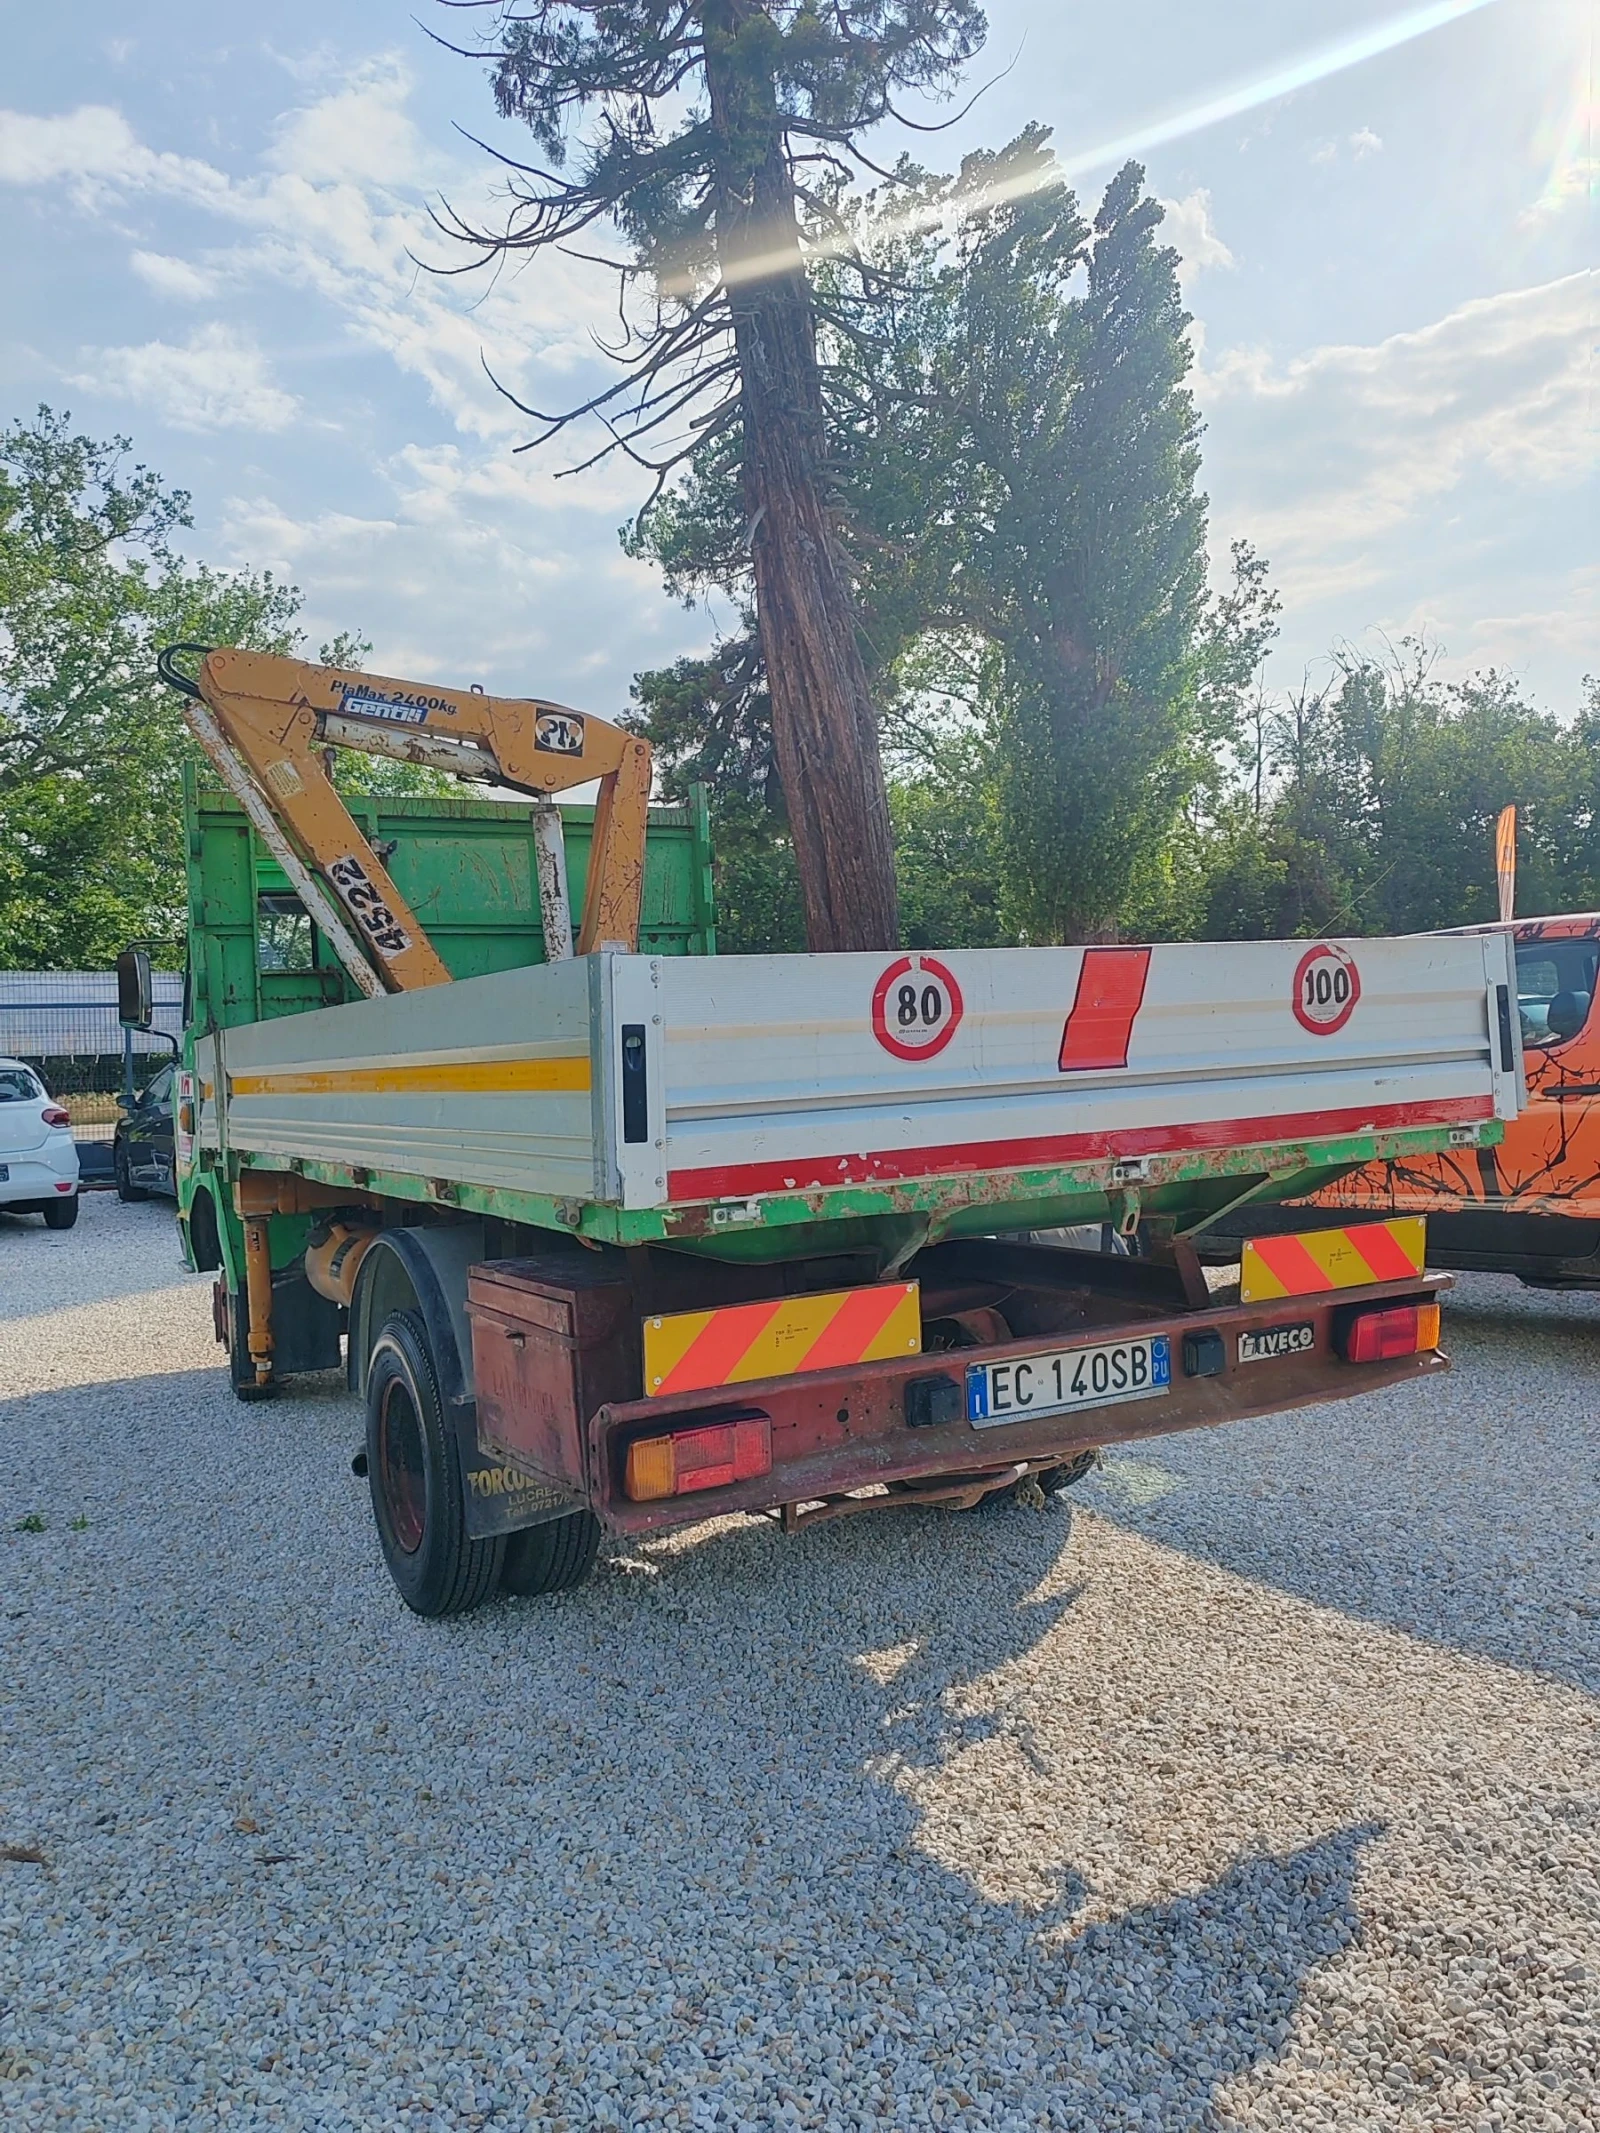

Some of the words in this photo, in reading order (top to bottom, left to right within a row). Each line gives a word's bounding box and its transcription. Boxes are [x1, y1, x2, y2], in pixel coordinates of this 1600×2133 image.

[332, 858, 406, 951] 4522
[897, 984, 942, 1026] 80
[1305, 967, 1349, 1006] 100
[1259, 1327, 1313, 1354] IVECO
[992, 1363, 1034, 1411] EC
[1051, 1345, 1148, 1401] 140SB
[1153, 1361, 1167, 1380] PU
[508, 1487, 560, 1505] LUCRE
